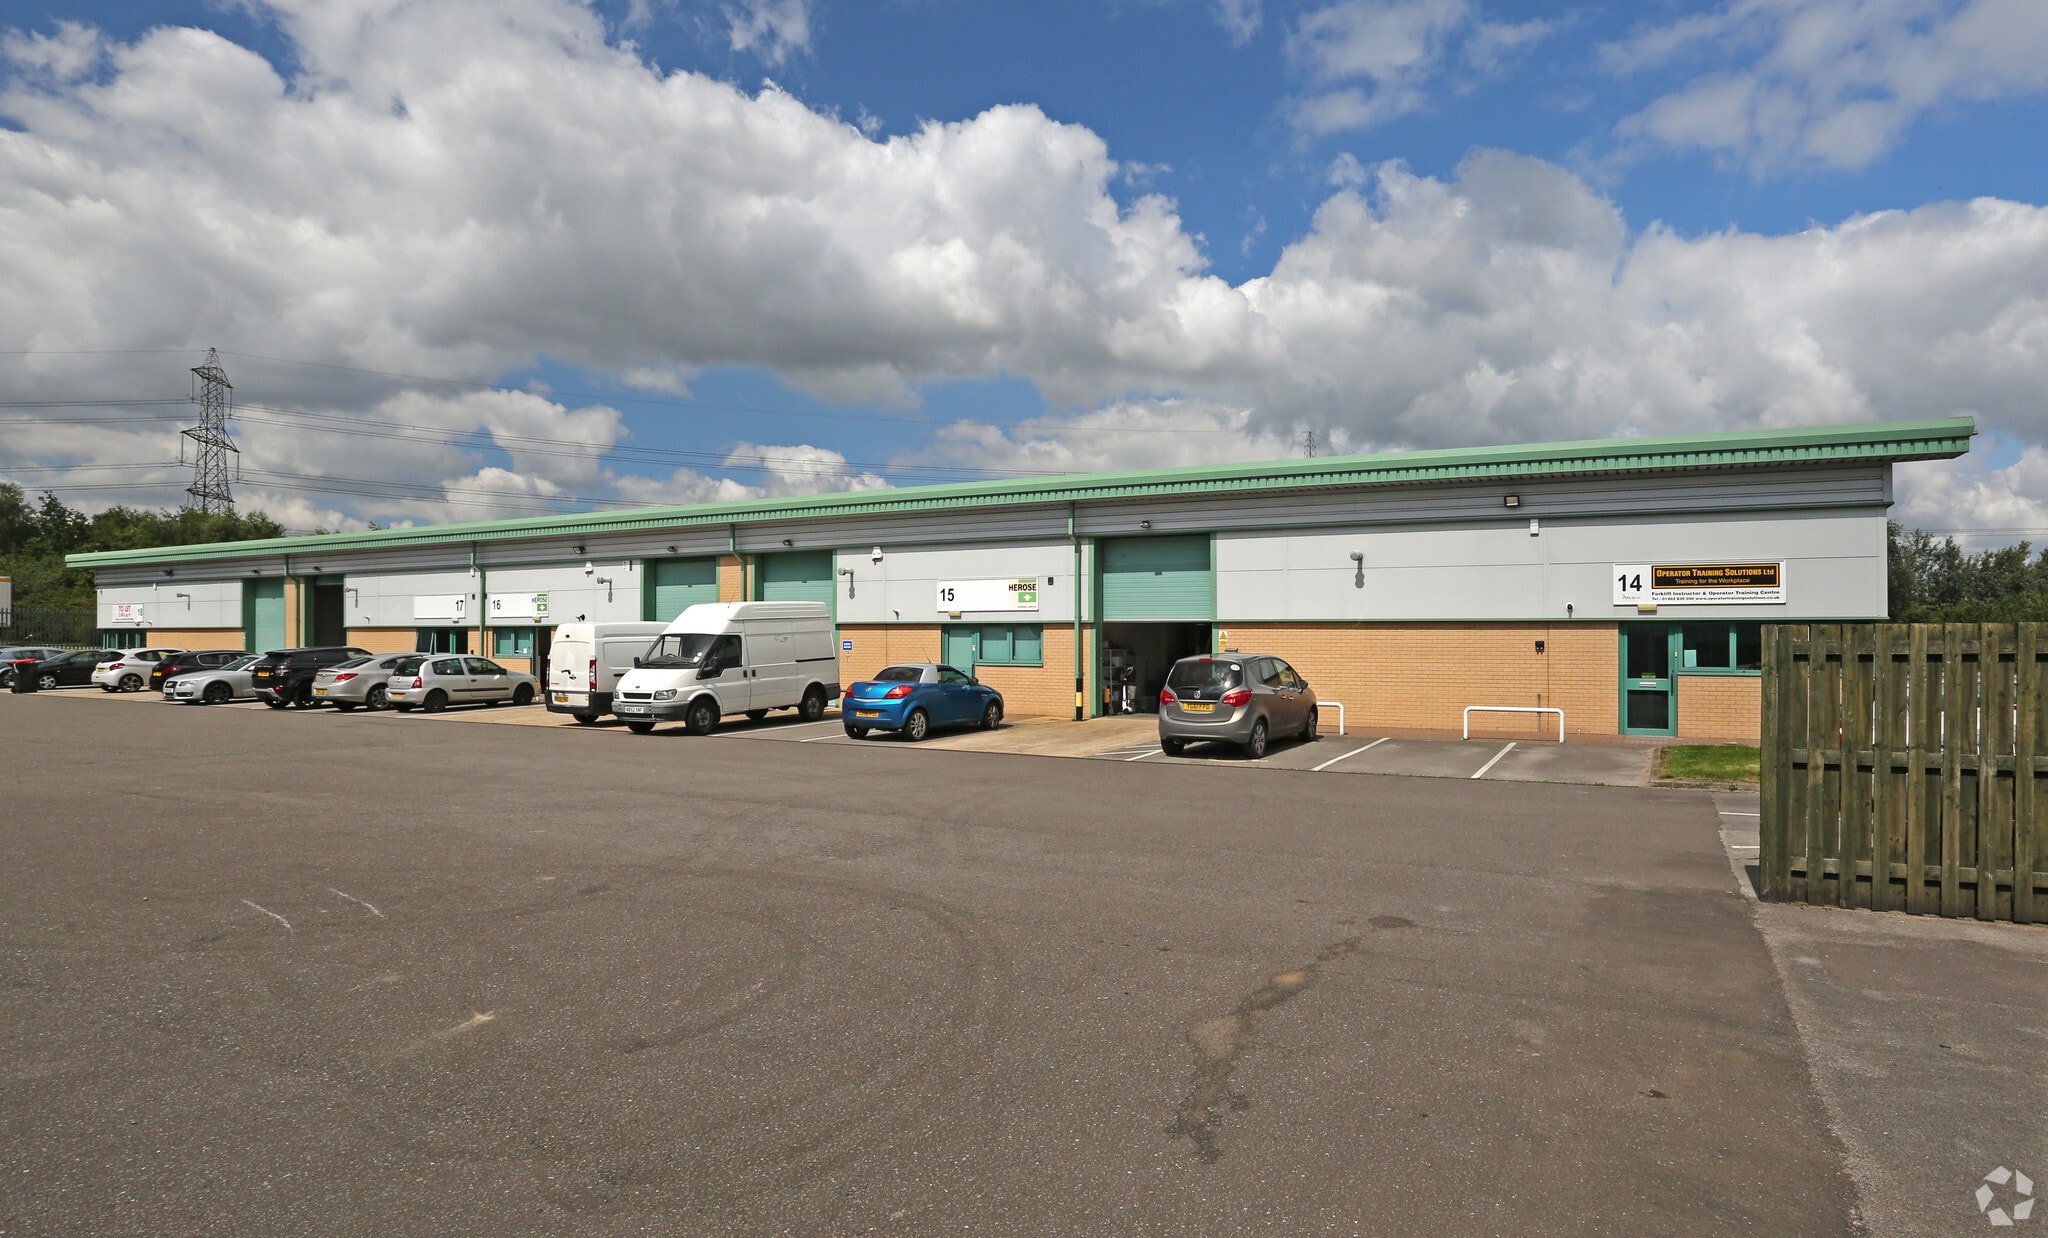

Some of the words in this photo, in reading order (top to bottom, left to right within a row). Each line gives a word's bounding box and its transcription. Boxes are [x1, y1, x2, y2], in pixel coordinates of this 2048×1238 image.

[1656, 569, 1691, 577] OPERATOR
[1692, 569, 1723, 577] TRAINING
[1724, 568, 1762, 576] SOLUTIONS
[1763, 568, 1774, 576] Ltd
[1008, 583, 1037, 592] HEROSE
[1618, 574, 1643, 592] 14
[940, 588, 955, 602] 15
[455, 600, 464, 612] 17
[492, 600, 501, 610] 16
